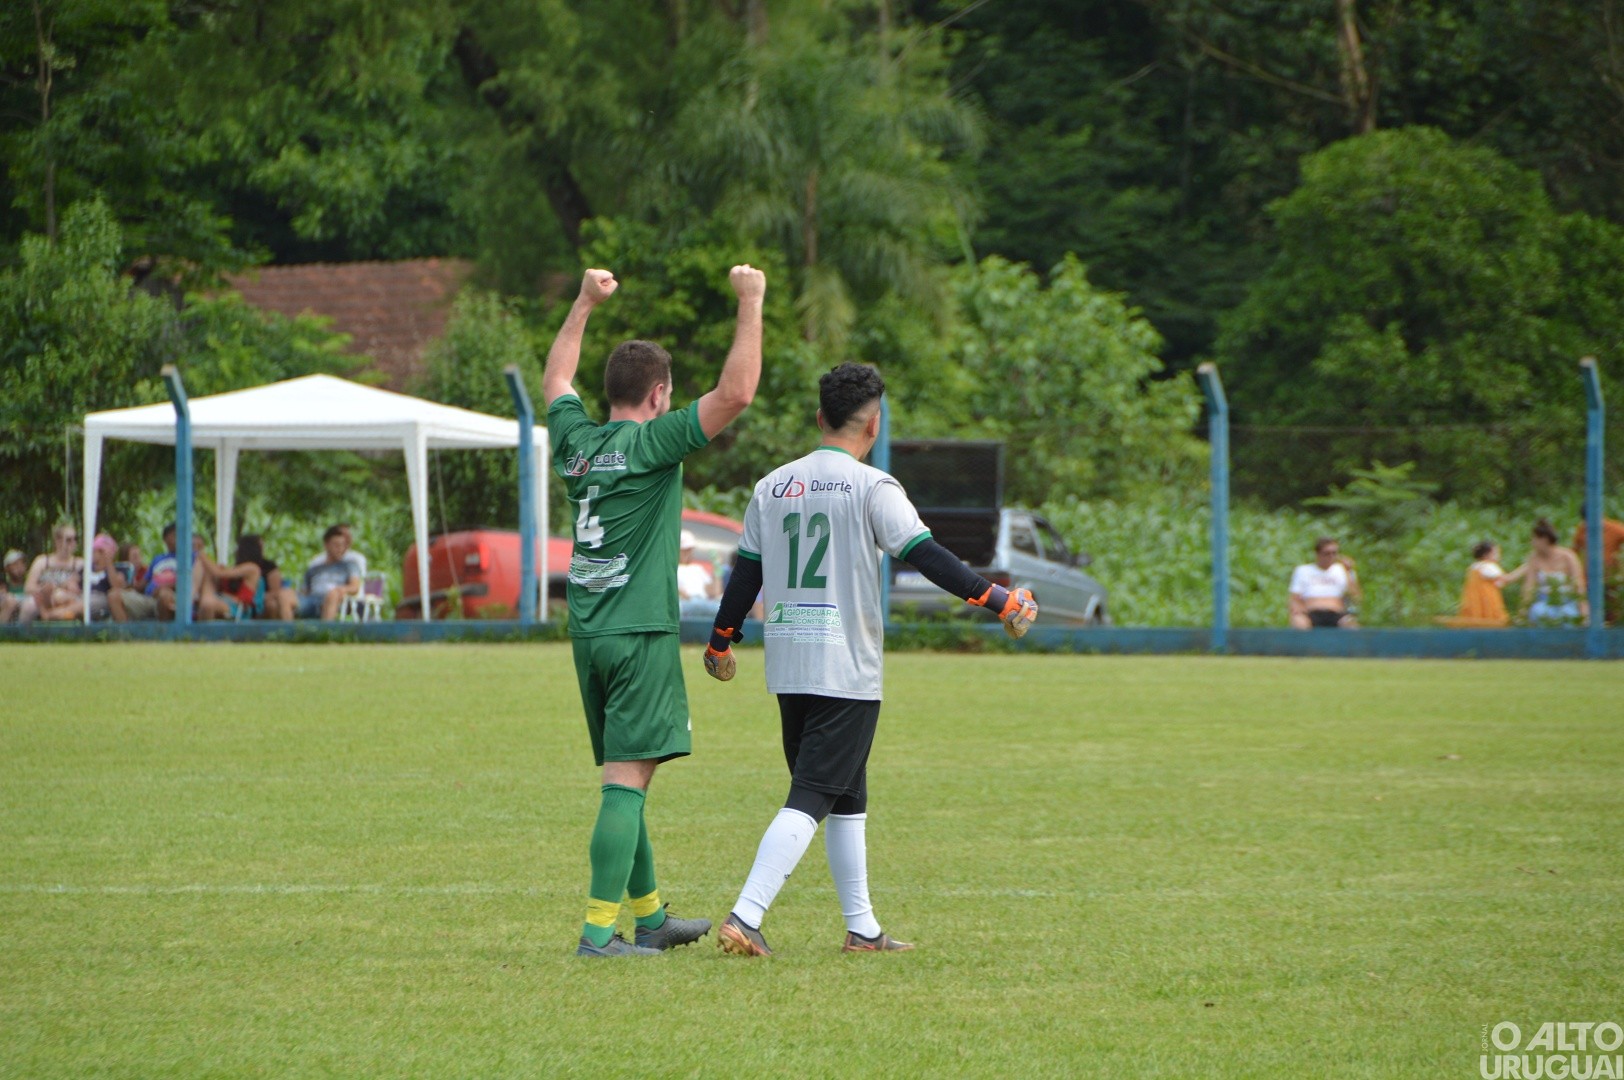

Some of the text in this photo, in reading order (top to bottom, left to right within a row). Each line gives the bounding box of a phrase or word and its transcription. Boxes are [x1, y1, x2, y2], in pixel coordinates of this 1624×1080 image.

[576, 485, 605, 549] 4
[810, 479, 852, 493] Duarte
[783, 512, 831, 589] 12
